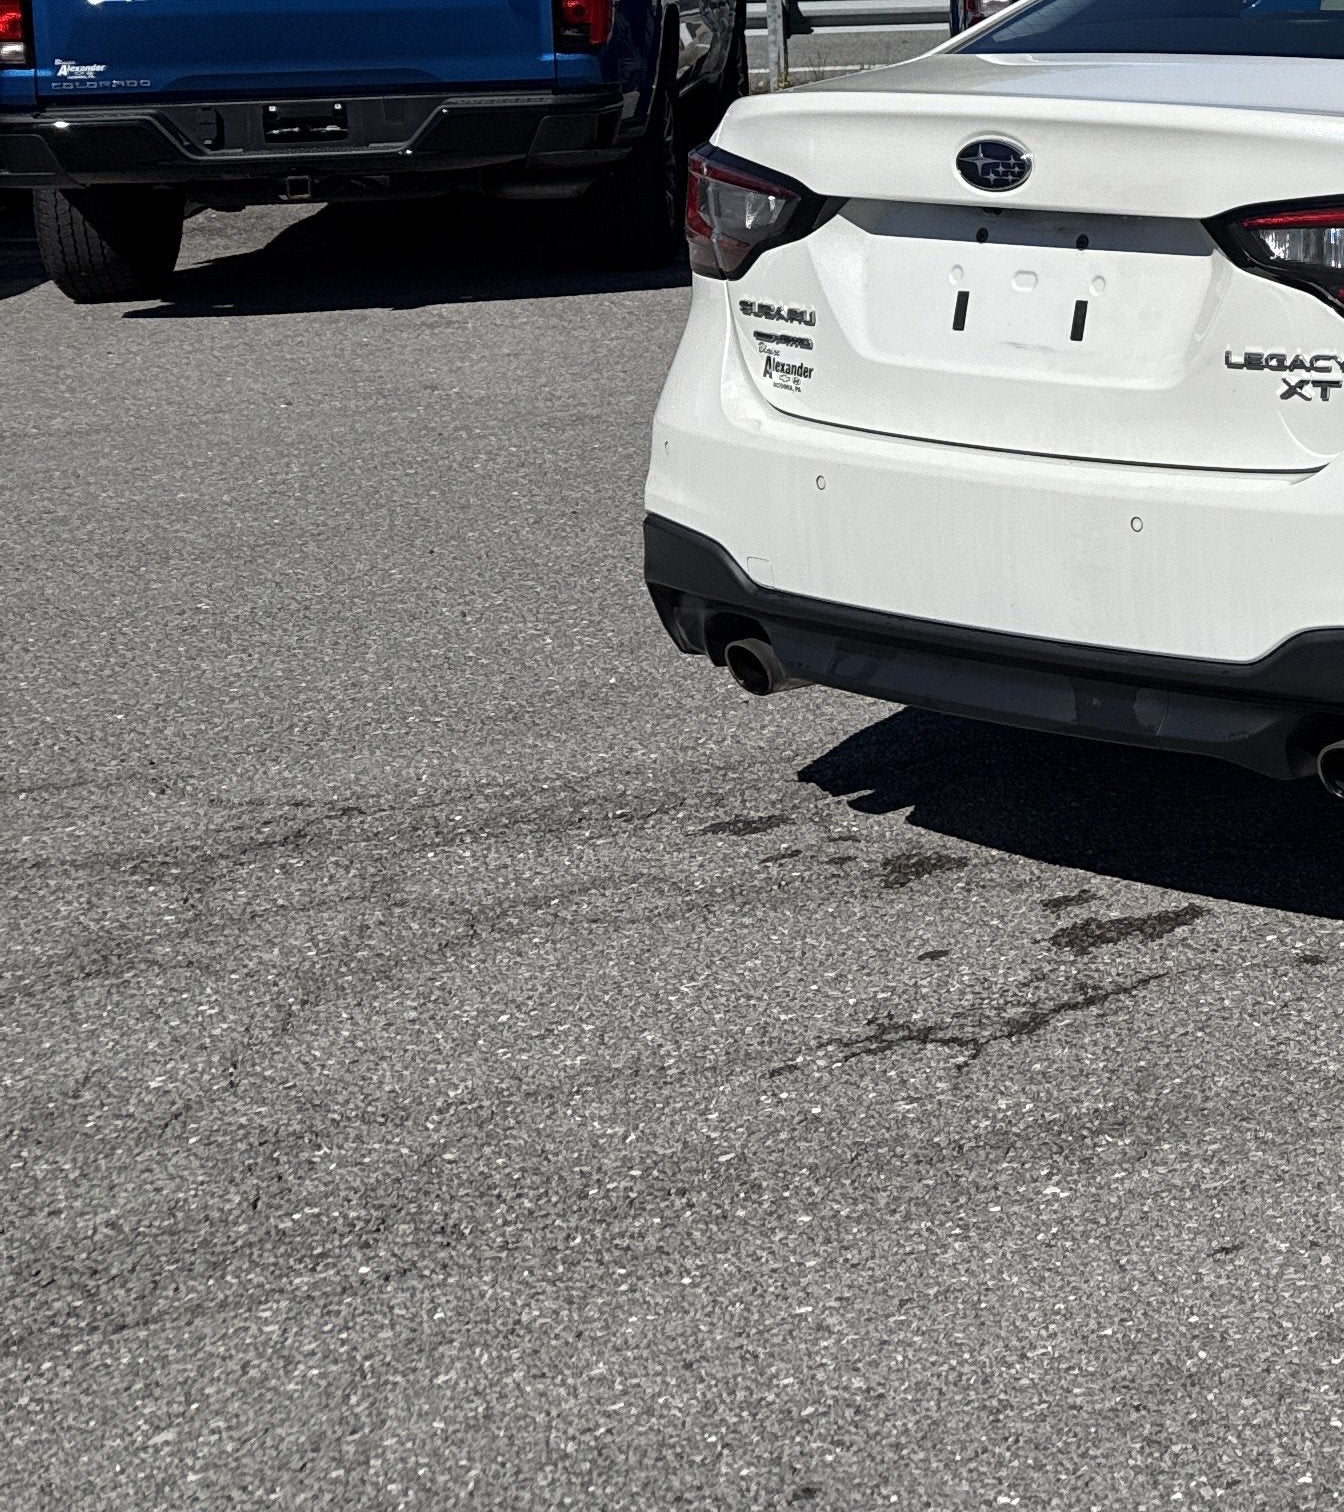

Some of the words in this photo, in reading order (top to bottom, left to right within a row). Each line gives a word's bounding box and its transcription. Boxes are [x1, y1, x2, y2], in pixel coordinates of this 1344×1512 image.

[51, 79, 151, 89] COLORADO
[739, 300, 816, 327] SUBARU
[762, 355, 814, 379] Alexander
[1279, 377, 1342, 401] XT
